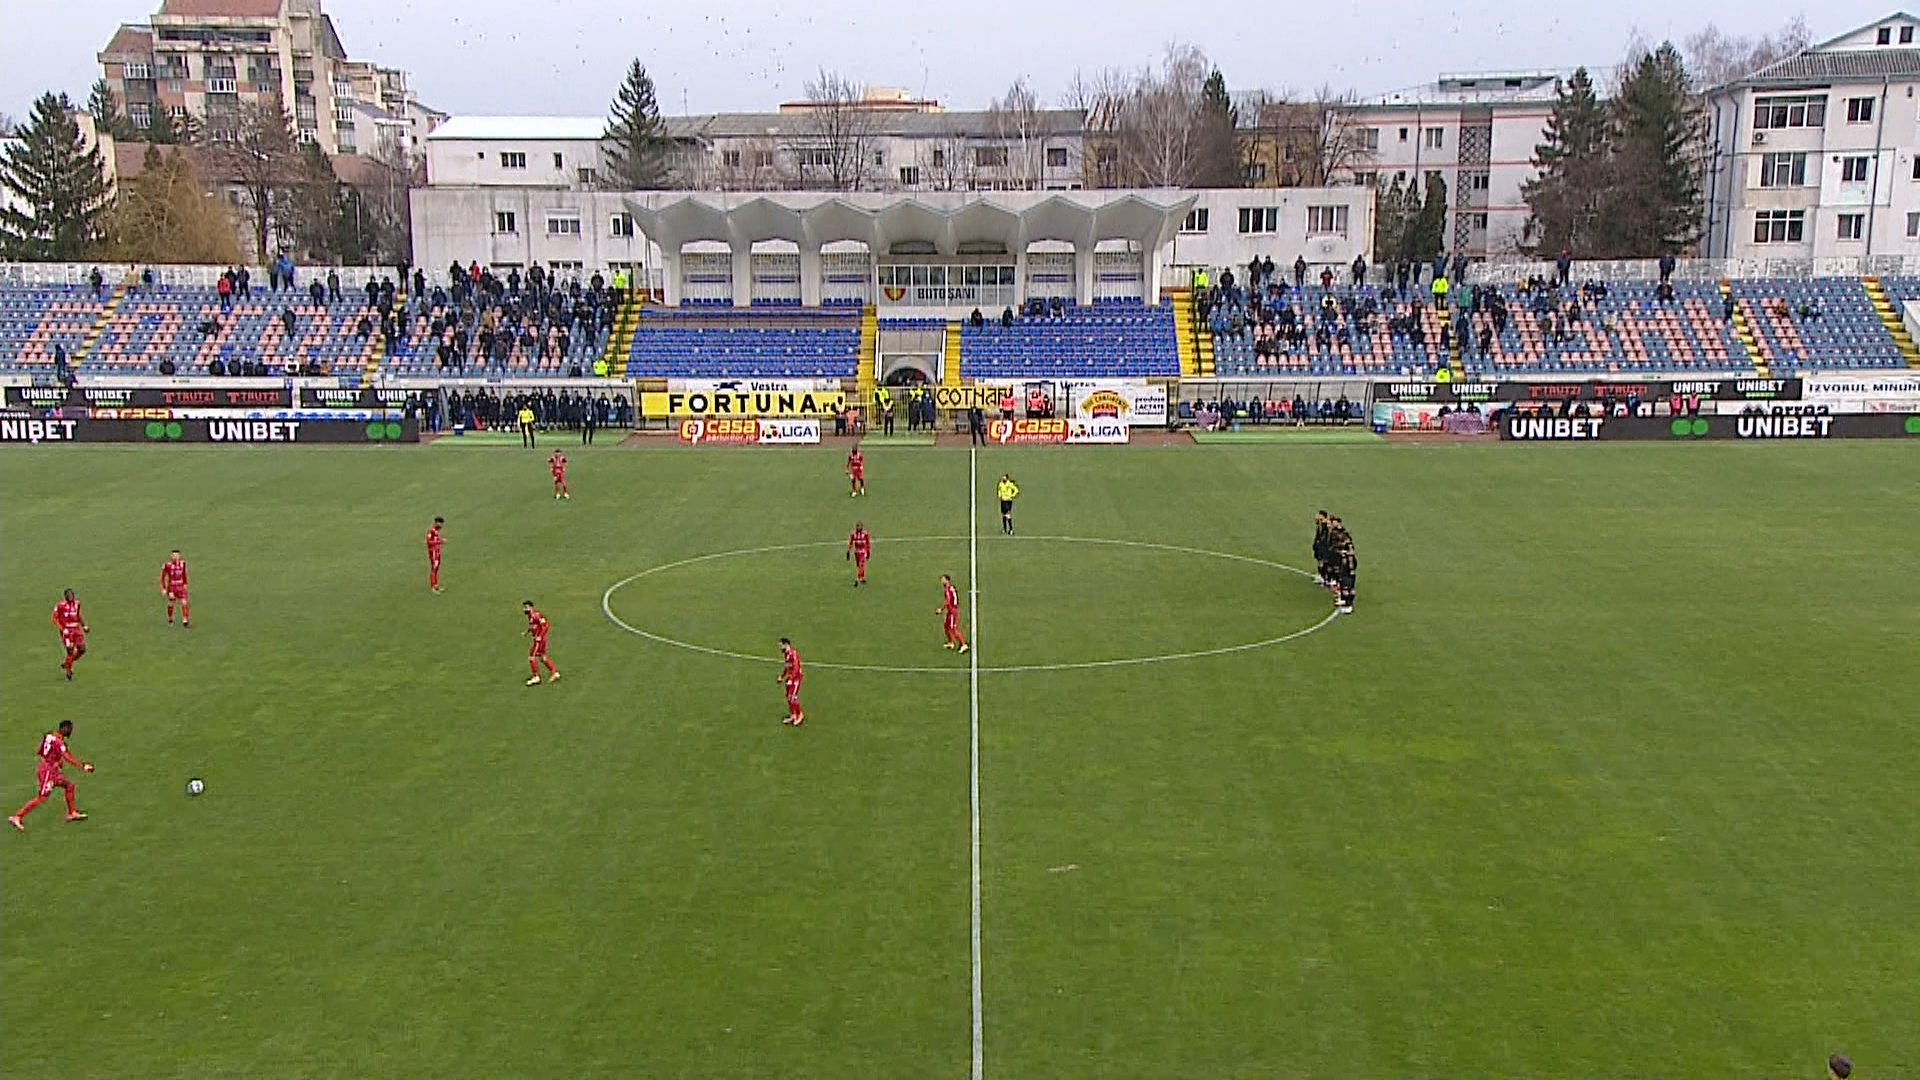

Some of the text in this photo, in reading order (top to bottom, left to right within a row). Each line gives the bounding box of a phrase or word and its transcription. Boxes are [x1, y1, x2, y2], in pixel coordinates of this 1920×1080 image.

[1391, 384, 1437, 394] UNIBET
[1452, 384, 1498, 394] UNIBET
[1673, 382, 1720, 393] UNIBET
[1737, 380, 1785, 391] UNIBET
[22, 389, 69, 399] UNIBET
[85, 390, 132, 399] UNIBET
[316, 390, 362, 400] UNIBET
[209, 421, 300, 441] UNIBET
[707, 419, 756, 434] casa
[782, 426, 813, 437] LIGA
[1015, 419, 1065, 433] casa
[1091, 426, 1121, 437] LIGA
[1511, 418, 1603, 438] UNIBET
[1738, 416, 1834, 436] UNIBET
